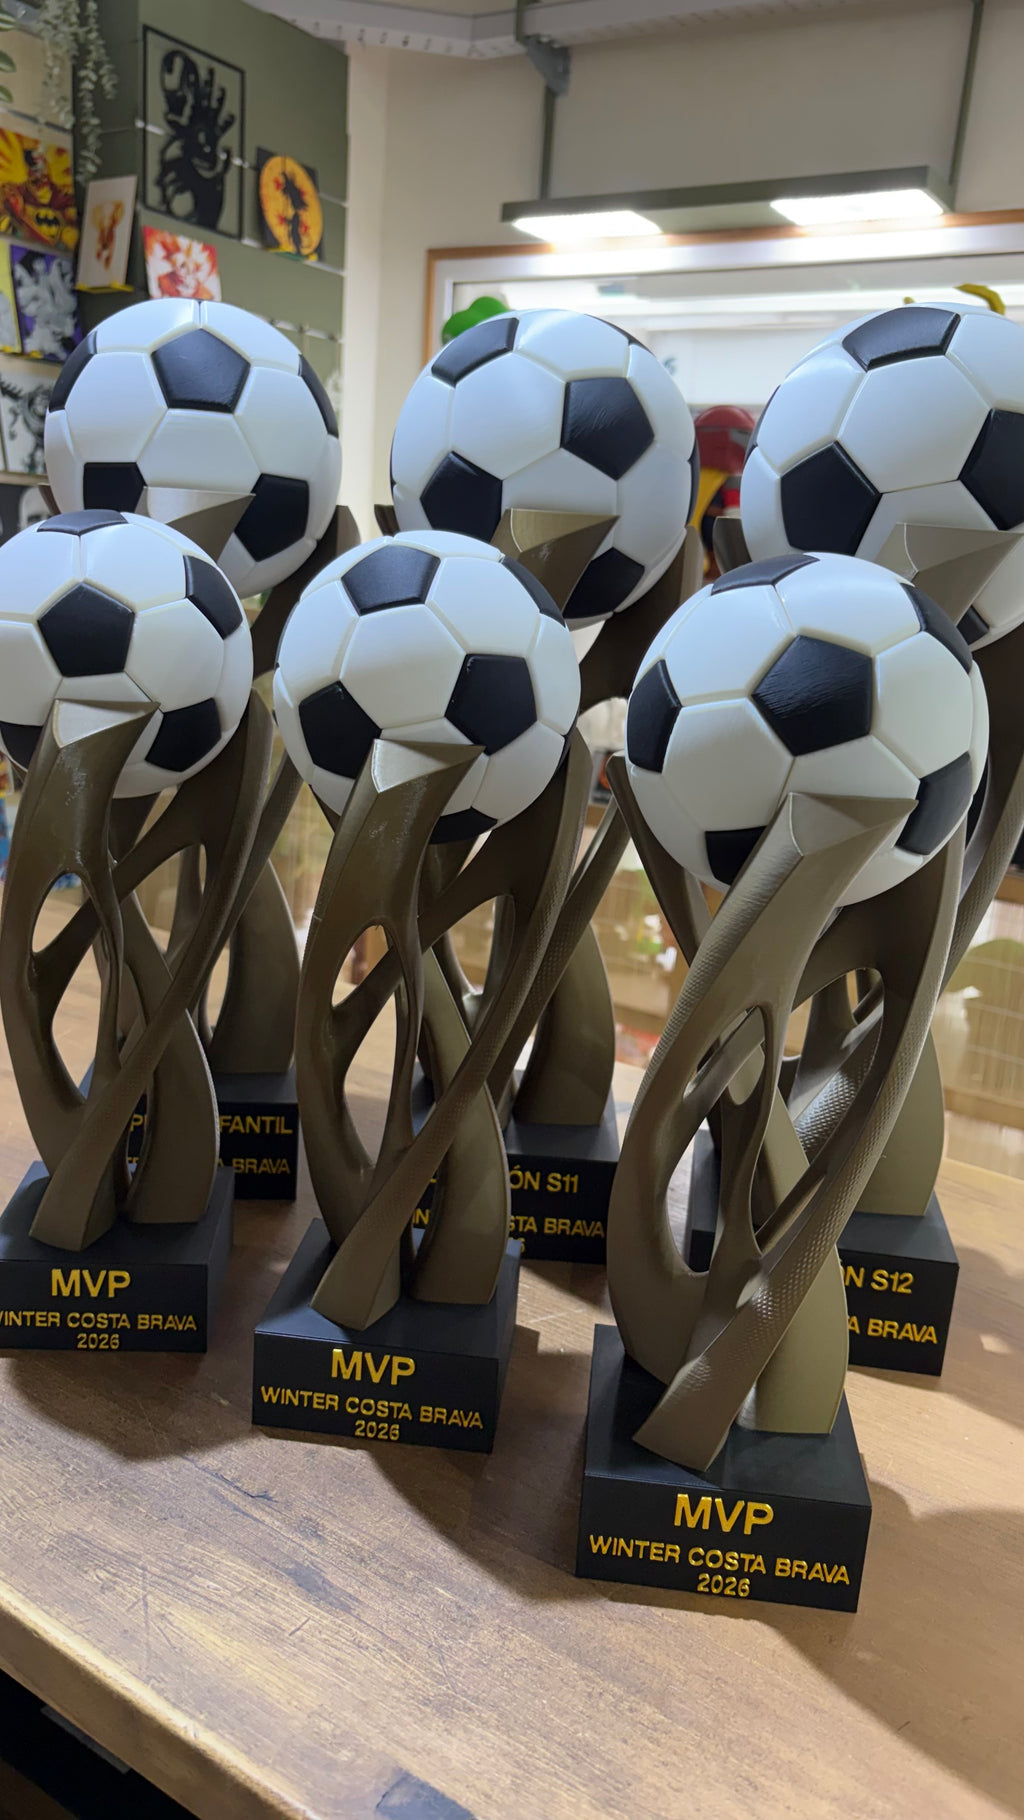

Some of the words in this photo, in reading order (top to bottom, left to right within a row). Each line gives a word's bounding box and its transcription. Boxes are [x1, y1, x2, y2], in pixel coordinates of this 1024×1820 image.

[231, 1157, 290, 1174] BRAVA
[546, 1172, 579, 1193] S11
[544, 1217, 605, 1238] BRAVA
[51, 1268, 131, 1298] MVP
[870, 1269, 914, 1294] S12
[66, 1312, 131, 1329] COSTA
[137, 1313, 197, 1331] BRAVA
[867, 1318, 938, 1345] BRAVA
[77, 1333, 120, 1350] 2026
[331, 1349, 416, 1386] MVP
[260, 1386, 340, 1411] WINTER
[345, 1396, 413, 1421] COSTA
[419, 1405, 483, 1429] BRAVA
[354, 1420, 400, 1441] 2026
[673, 1493, 774, 1536] MVP
[589, 1534, 681, 1564] WINTER
[687, 1547, 767, 1575] COSTA
[774, 1557, 850, 1585] BRAVA
[697, 1573, 751, 1598] 2026
